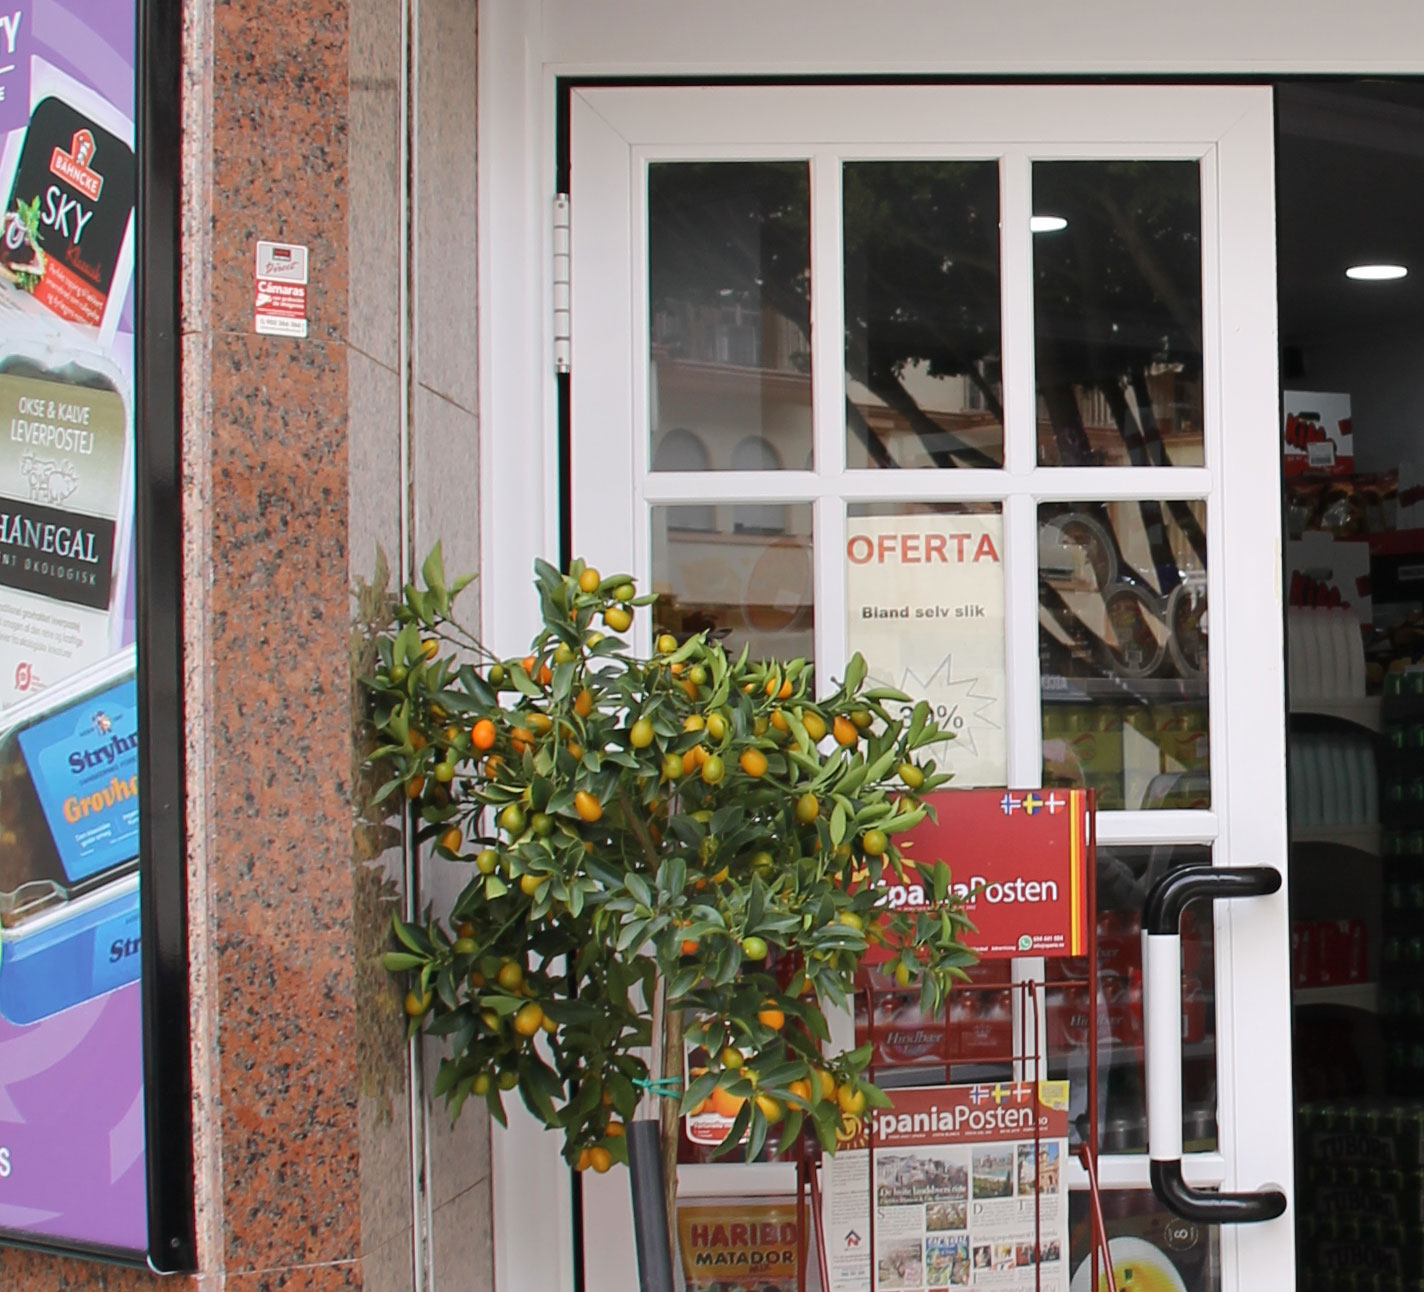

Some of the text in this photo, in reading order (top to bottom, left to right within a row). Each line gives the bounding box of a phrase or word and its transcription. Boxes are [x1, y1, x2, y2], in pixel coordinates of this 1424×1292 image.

[41, 185, 94, 244] SKY
[18, 397, 90, 426] OKSE & KALVE
[10, 419, 94, 455] LEVERPOSTEJ
[846, 533, 1000, 565] OFERTA
[861, 604, 985, 619] Bland selv slik
[691, 1222, 798, 1248] HARIBO
[695, 1250, 794, 1266] MATADOR
